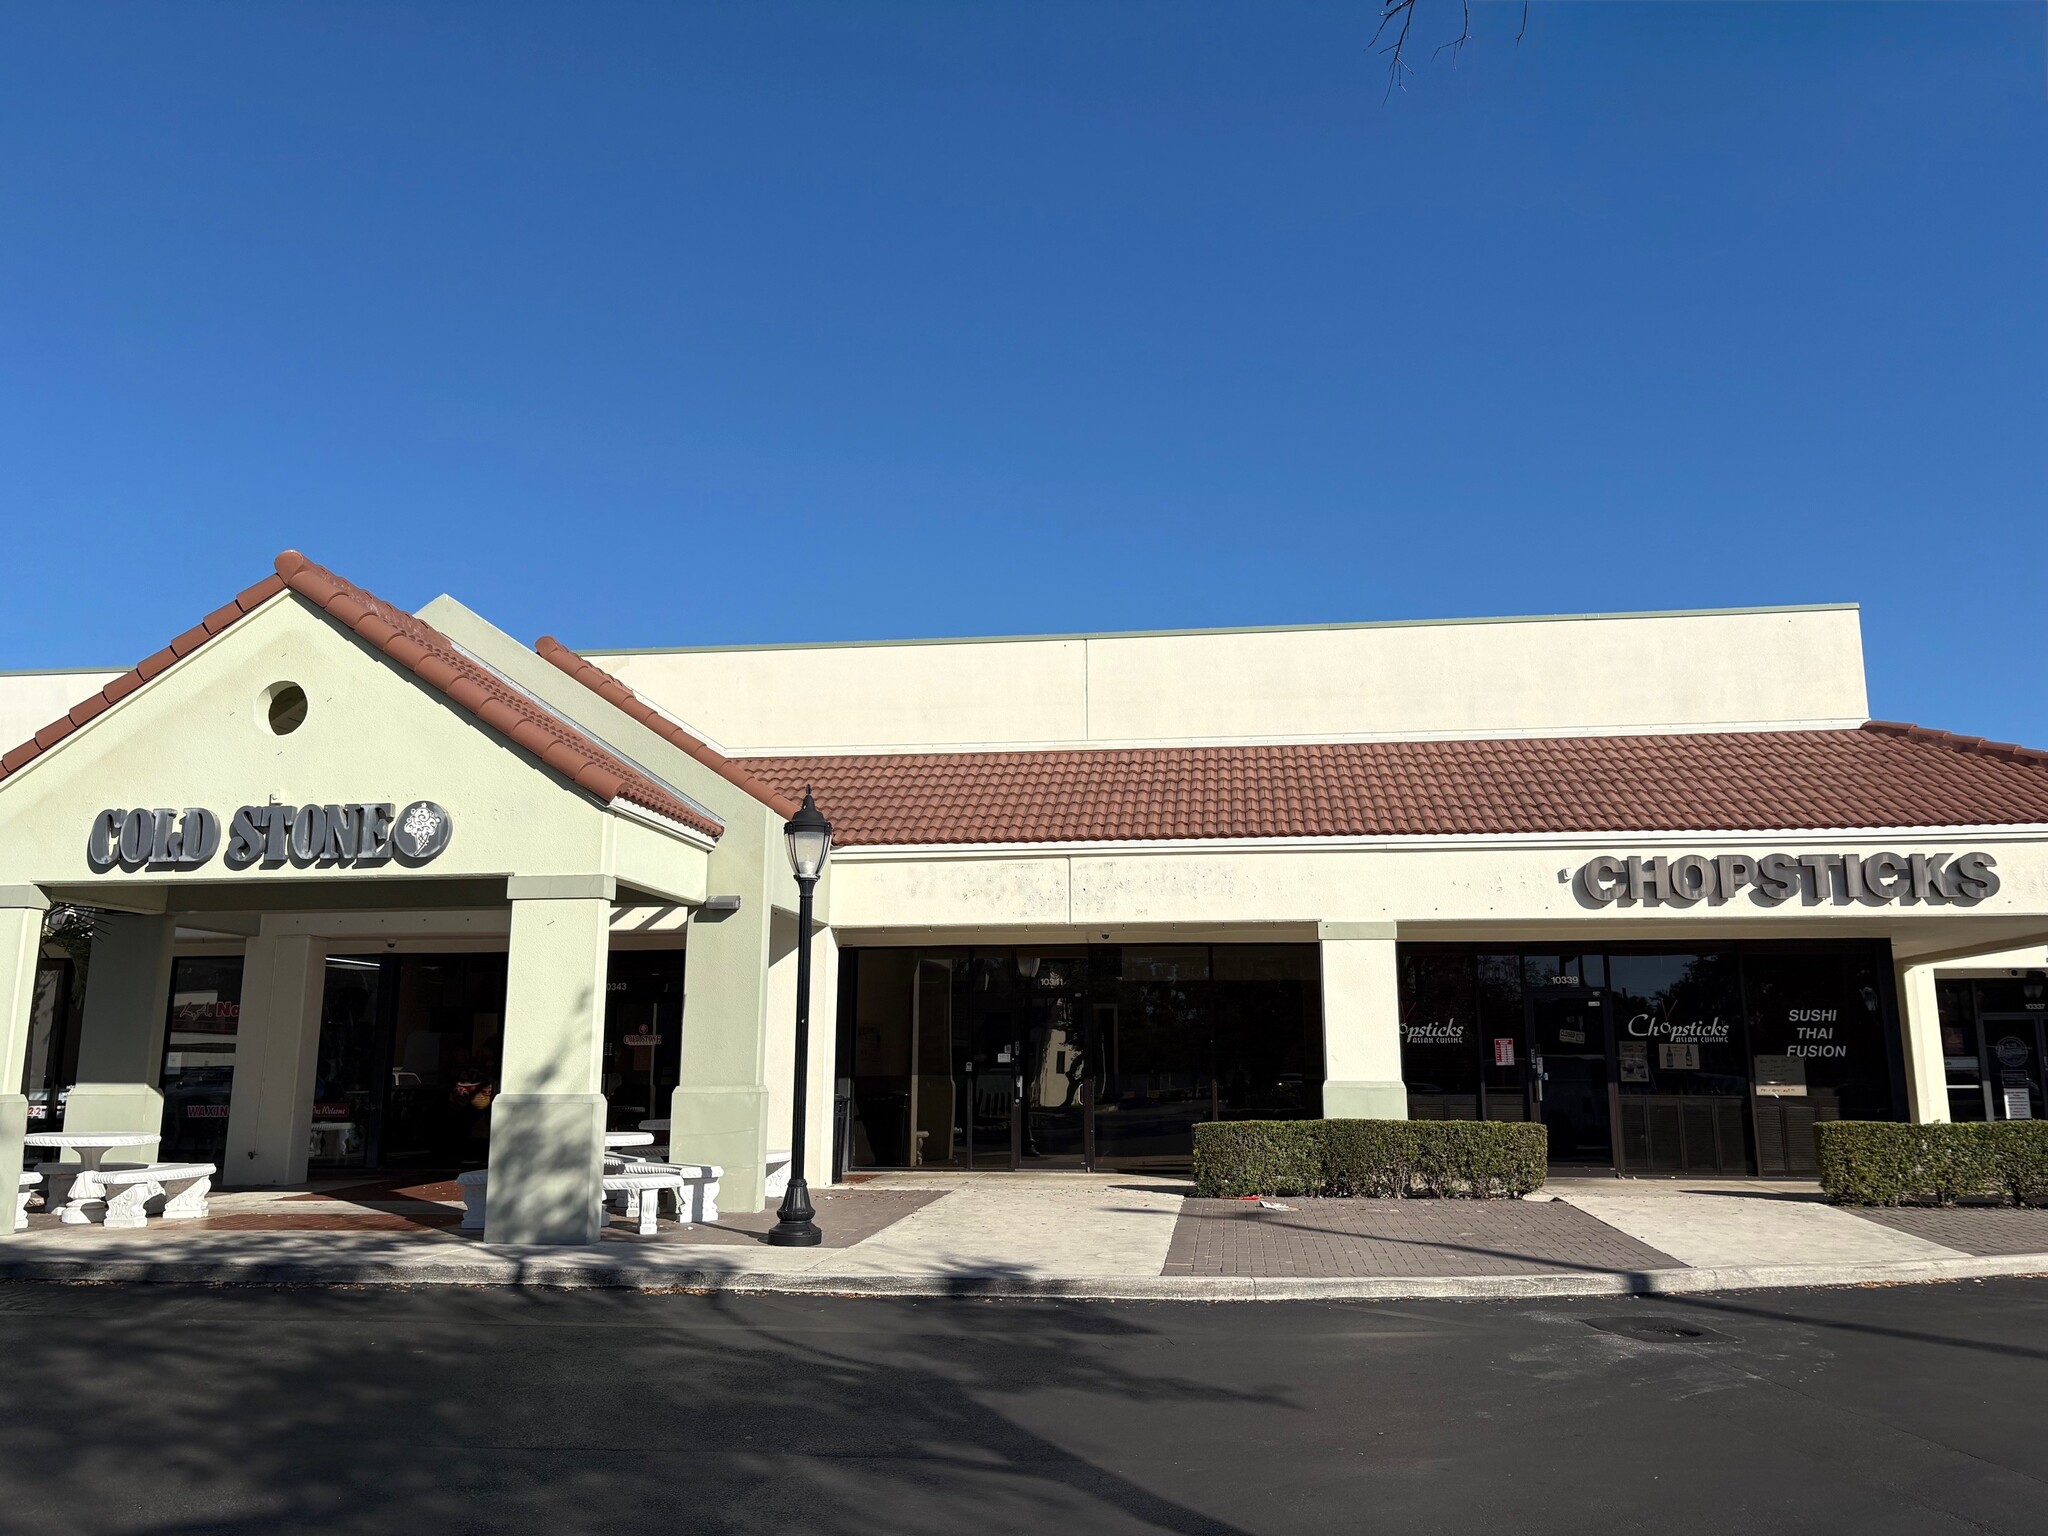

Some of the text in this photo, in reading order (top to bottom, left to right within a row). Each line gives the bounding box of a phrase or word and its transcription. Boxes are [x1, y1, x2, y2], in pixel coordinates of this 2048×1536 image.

[89, 803, 396, 866] COLD STONE
[1583, 851, 2001, 901] CHOPSTICKS
[606, 982, 627, 991] 0343
[1551, 976, 1579, 985] 10339
[216, 1001, 240, 1017] Na
[1788, 1009, 1837, 1021] SUSHI
[1399, 1017, 1464, 1043] opsticks
[1627, 1013, 1730, 1042] Chopsticks
[1796, 1027, 1834, 1039] THAI
[1786, 1045, 1847, 1057] FUSION
[187, 1105, 230, 1117] WAXIN
